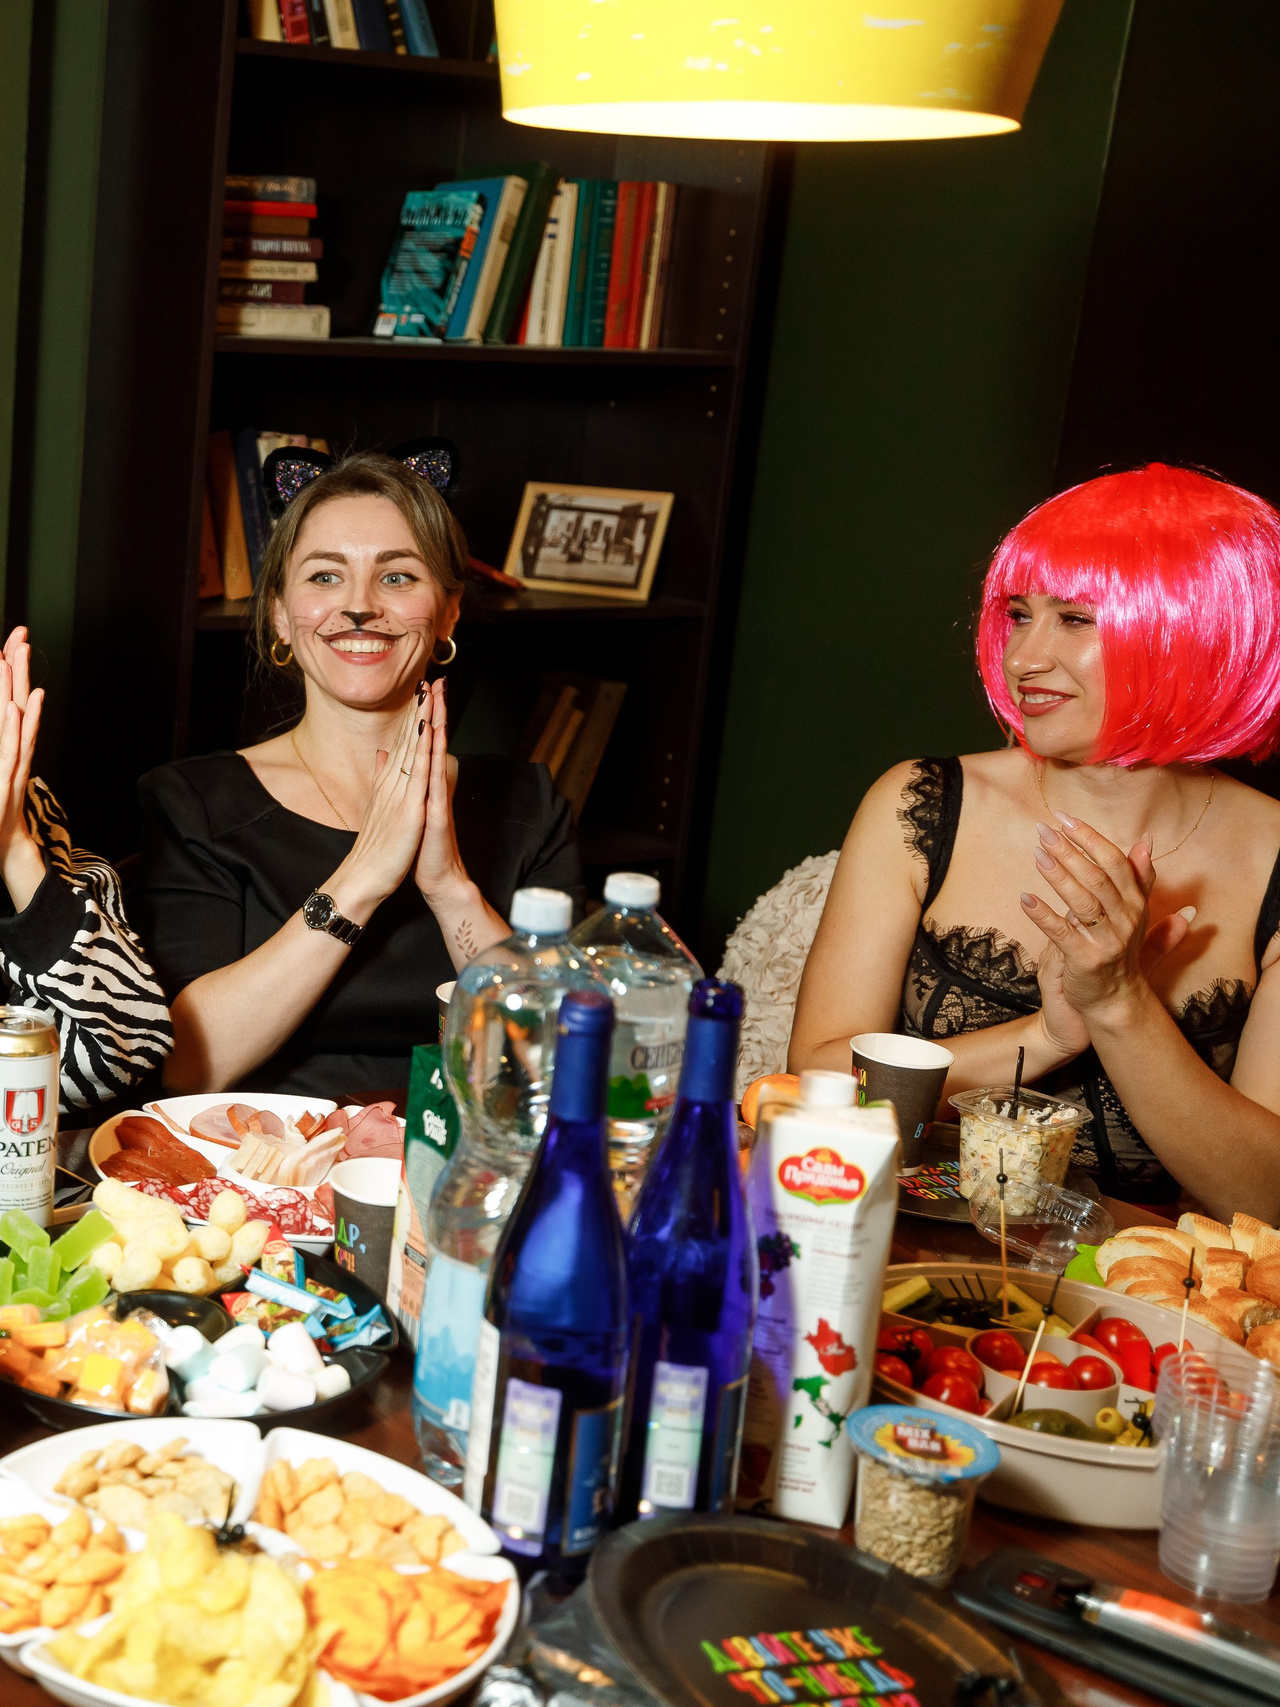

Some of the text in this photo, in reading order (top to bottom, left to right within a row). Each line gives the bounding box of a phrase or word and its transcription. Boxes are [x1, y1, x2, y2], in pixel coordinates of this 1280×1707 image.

[0, 1159, 47, 1179] Original
[801, 1156, 846, 1177] Сады
[907, 1186, 960, 1200] ДЕСЬ
[896, 1425, 931, 1439] MIX
[701, 1626, 883, 1674] ДАВАЙТЕ УЖЕ
[727, 1659, 916, 1704] ЧТО-НИБУДЬ
